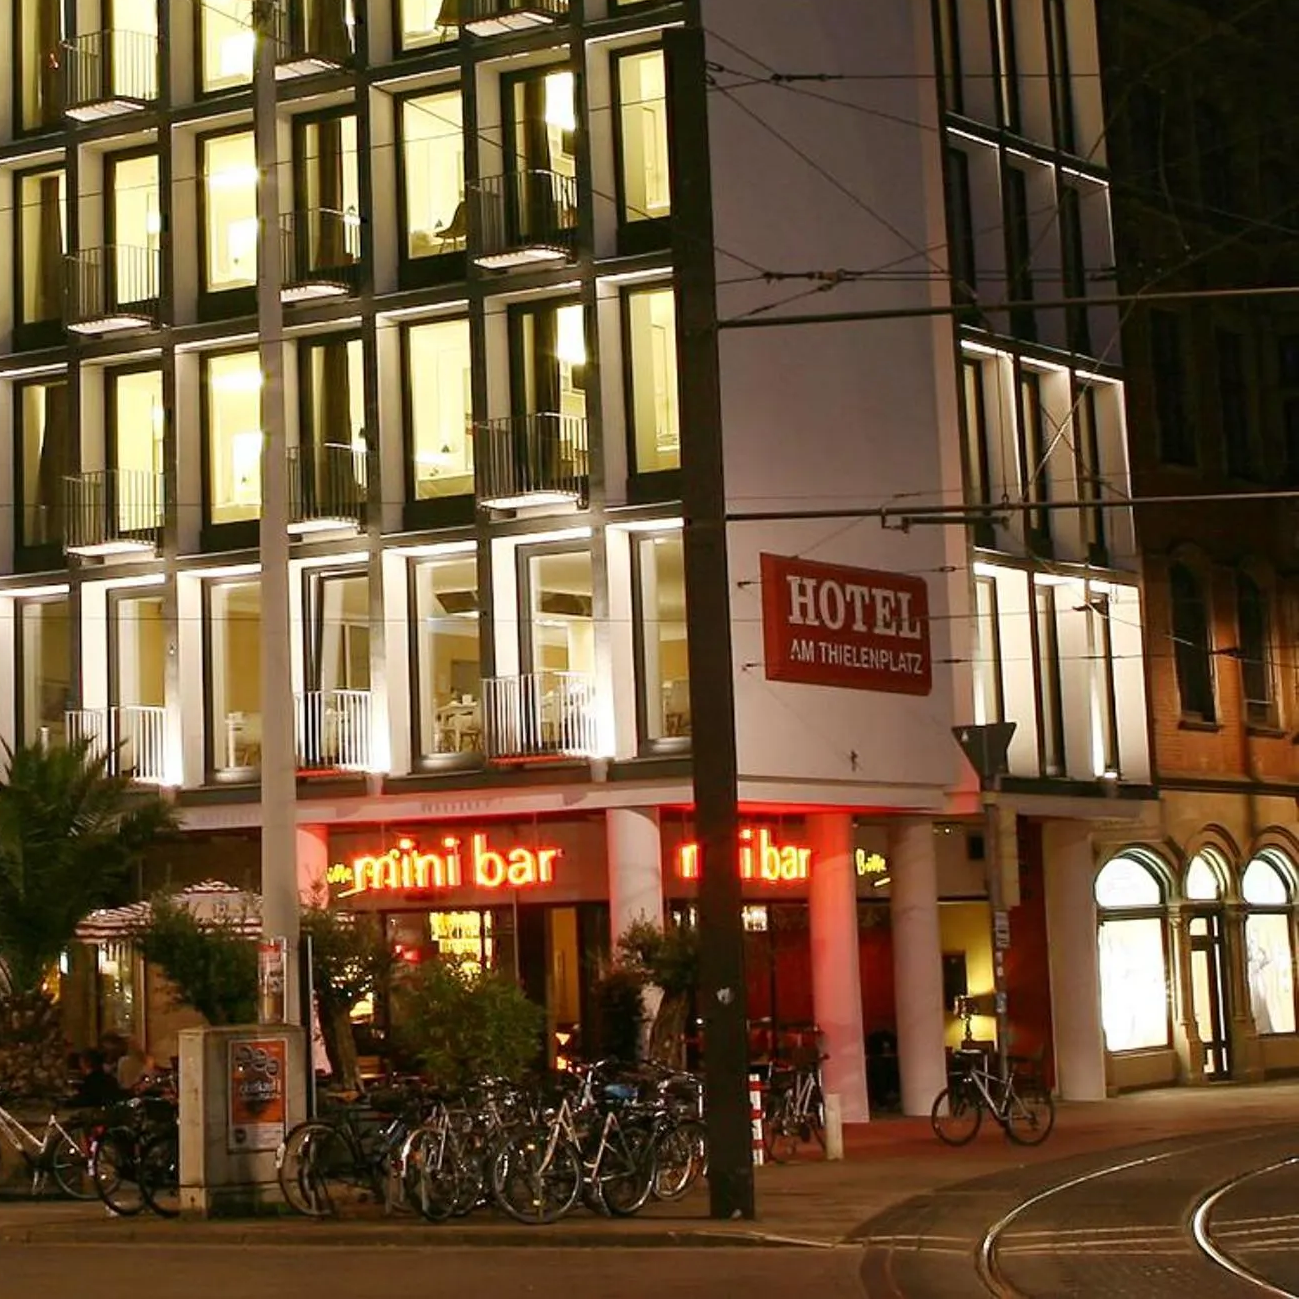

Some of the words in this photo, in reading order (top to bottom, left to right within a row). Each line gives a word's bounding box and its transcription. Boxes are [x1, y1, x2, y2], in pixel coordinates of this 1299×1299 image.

[786, 575, 922, 640] HOTEL
[790, 638, 815, 663] AM
[819, 641, 924, 675] THIELENPLATZ
[353, 837, 461, 890] mini
[473, 833, 558, 888] bar
[759, 828, 812, 881] bar
